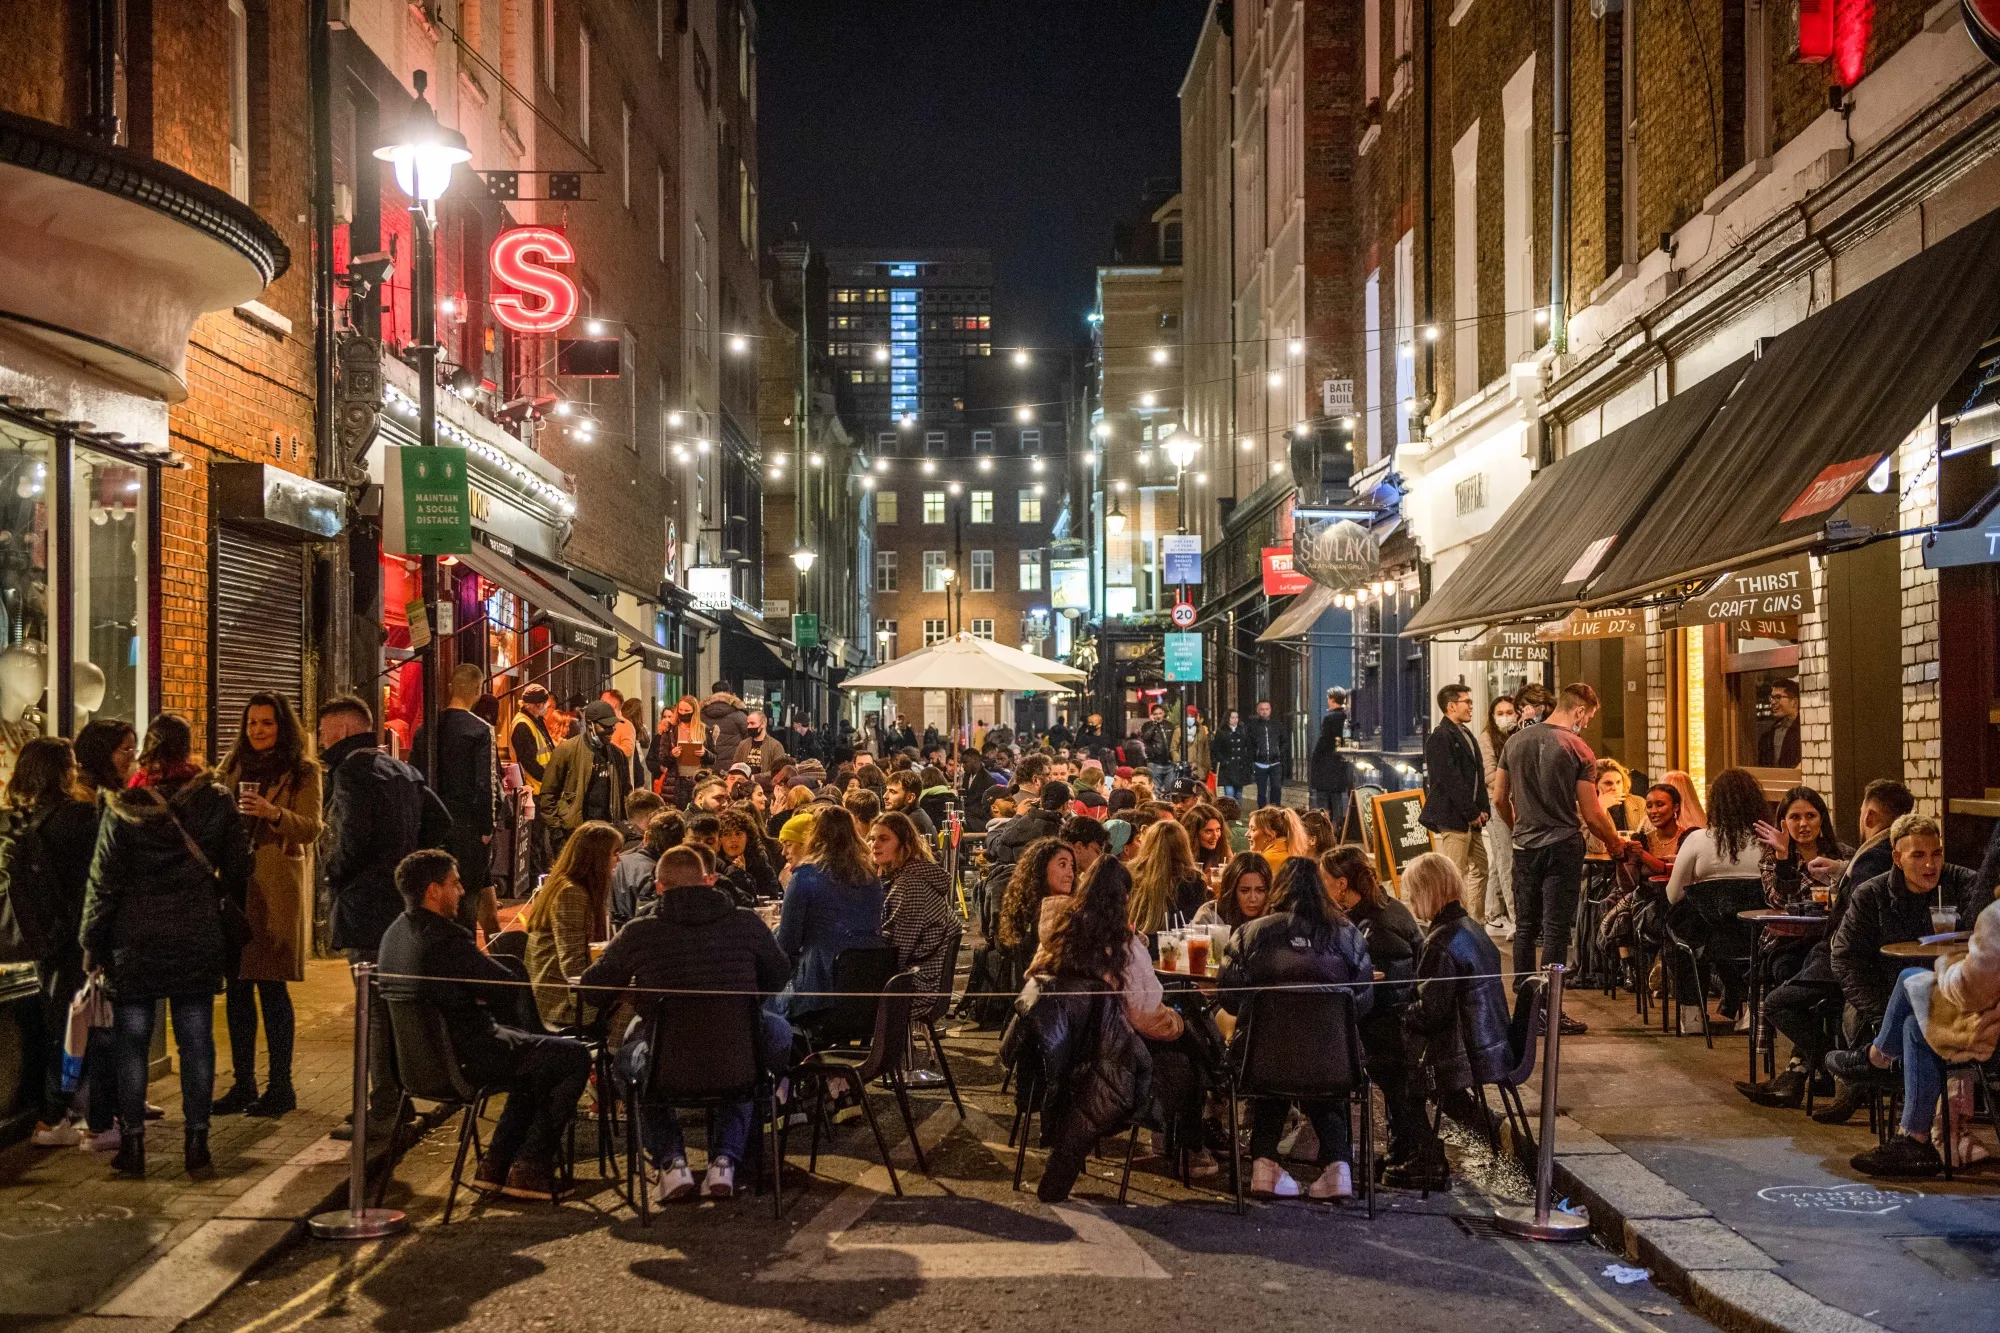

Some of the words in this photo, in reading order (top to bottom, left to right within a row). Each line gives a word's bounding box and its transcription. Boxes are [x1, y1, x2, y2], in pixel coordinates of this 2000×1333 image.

[490, 228, 578, 332] S
[415, 494, 459, 502] MAINTAIN
[417, 505, 424, 513] A
[426, 505, 459, 513] SOCIAL
[416, 516, 460, 524] DISTANCE
[1301, 537, 1371, 562] SUVLAKI
[1349, 562, 1364, 570] GRILL
[1735, 571, 1799, 594] THIRST
[692, 591, 726, 599] DONER
[692, 600, 728, 608] KEBAB
[1708, 598, 1758, 618] CRAFT
[1763, 594, 1802, 613] GINS
[1176, 610, 1193, 620] 20
[1573, 621, 1600, 636] LIVE
[1608, 620, 1636, 634] DJ's
[1493, 647, 1522, 660] LATE
[1528, 647, 1548, 660] BAR
